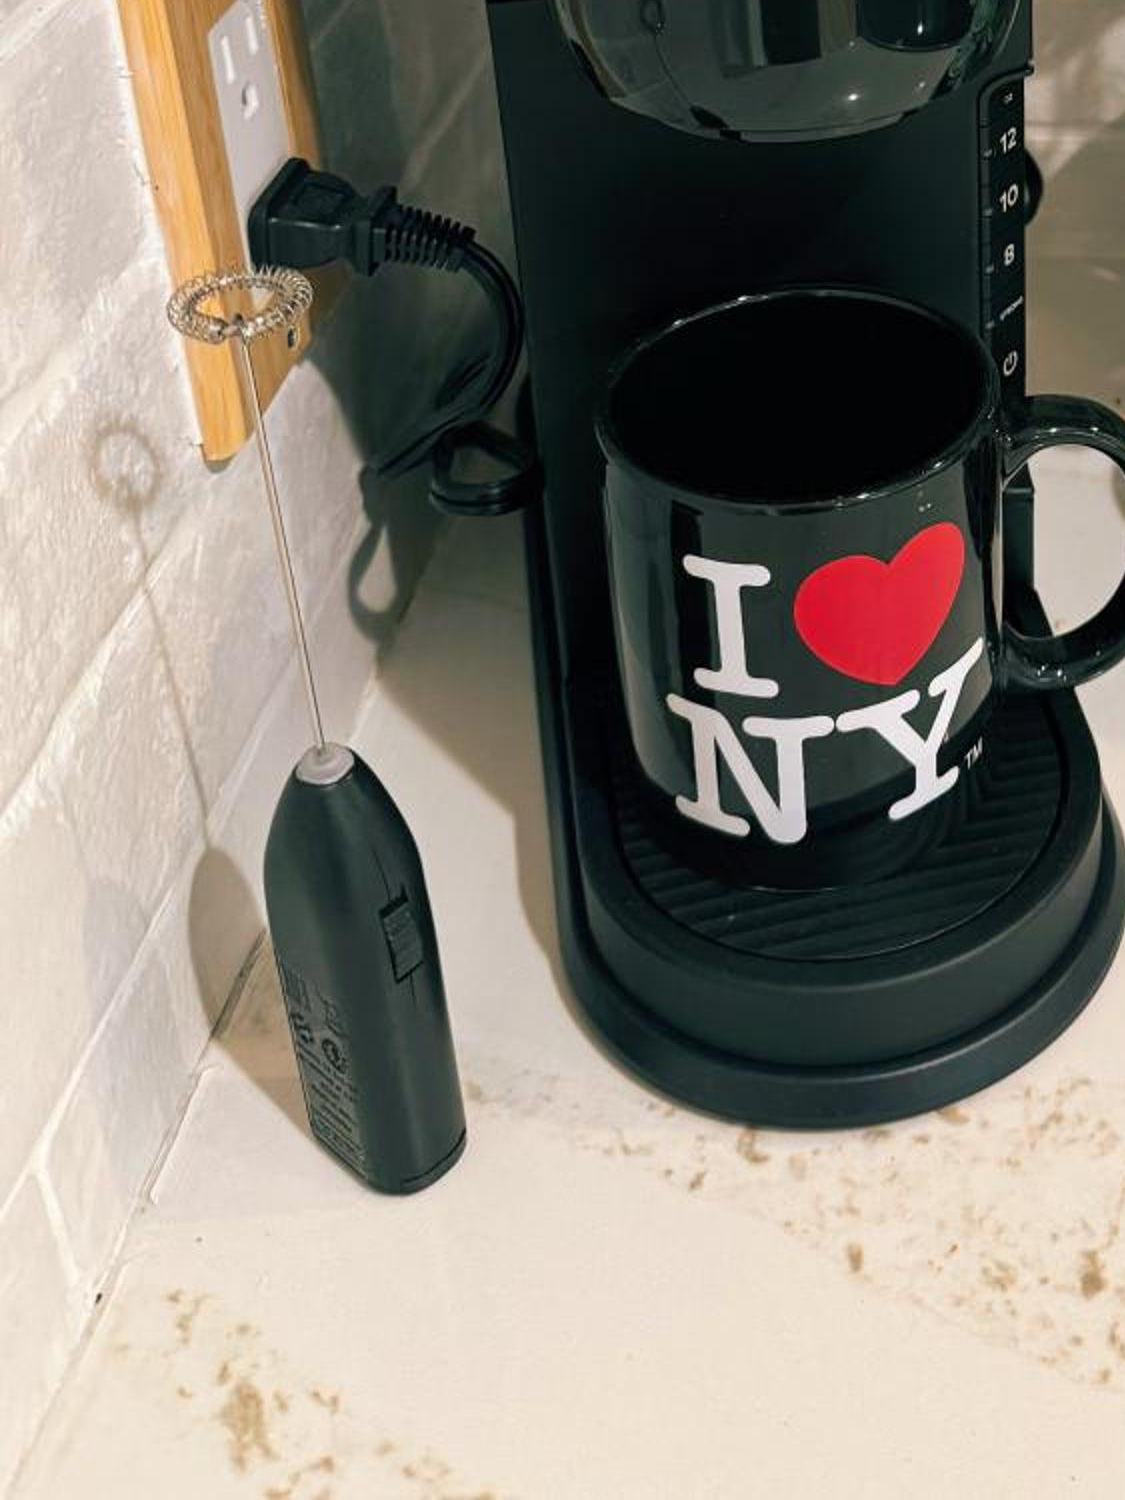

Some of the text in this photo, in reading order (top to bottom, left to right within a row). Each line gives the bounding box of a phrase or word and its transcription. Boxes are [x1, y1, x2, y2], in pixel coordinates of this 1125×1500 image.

[1000, 126, 1018, 154] 12
[1000, 184, 1019, 213] 10
[1003, 243, 1015, 267] 8
[682, 553, 779, 699] I
[665, 636, 984, 846] NY
